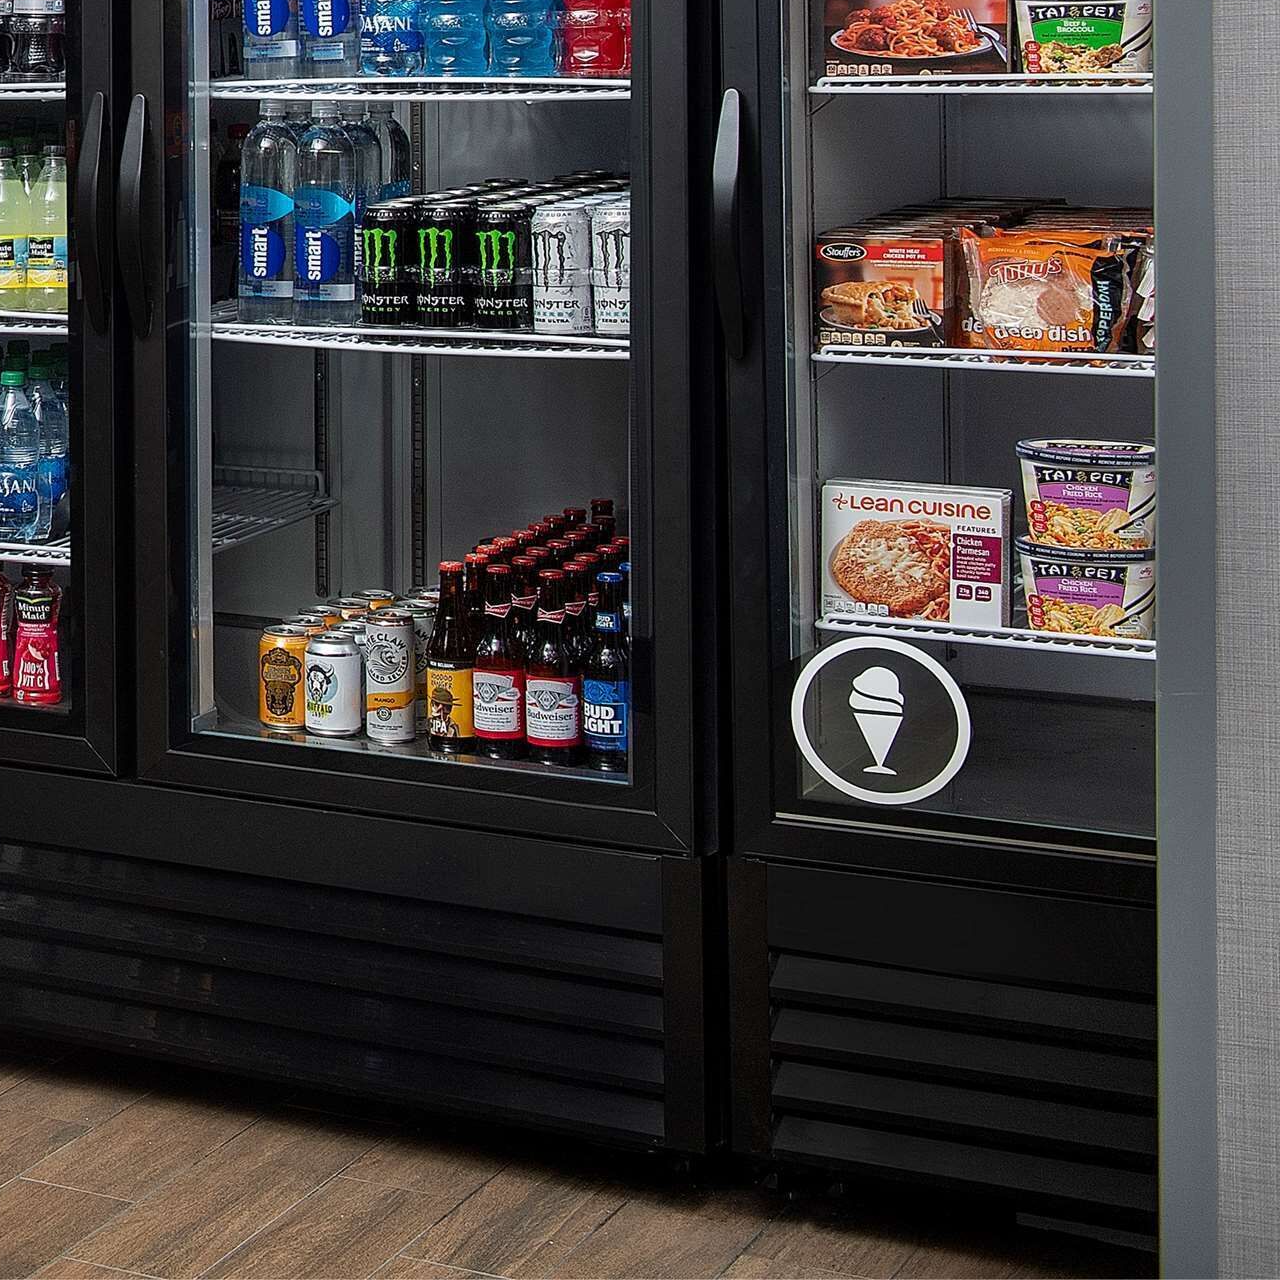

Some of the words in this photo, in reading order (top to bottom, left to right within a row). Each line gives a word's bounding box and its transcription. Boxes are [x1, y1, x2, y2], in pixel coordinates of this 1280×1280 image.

[1035, 6, 1065, 19] TAI
[1082, 6, 1115, 18] PEI
[252, 227, 268, 278] smart
[308, 231, 322, 282] smart
[825, 245, 862, 259] Stouffer's
[989, 257, 1062, 286] Tony's
[994, 324, 1042, 342] deep
[1047, 322, 1092, 342] dish
[1042, 470, 1073, 481] TAI
[1090, 473, 1121, 484] PEI
[849, 494, 904, 513] Lean
[956, 525, 997, 534] FEATURES
[956, 536, 983, 547] Chicken
[956, 545, 990, 557] Parmesan
[1038, 564, 1067, 575] TAI
[1084, 568, 1115, 579] PEI
[18, 602, 50, 613] Minute
[21, 611, 46, 620] Maid
[377, 633, 406, 651] CLAW
[584, 704, 615, 719] BUD
